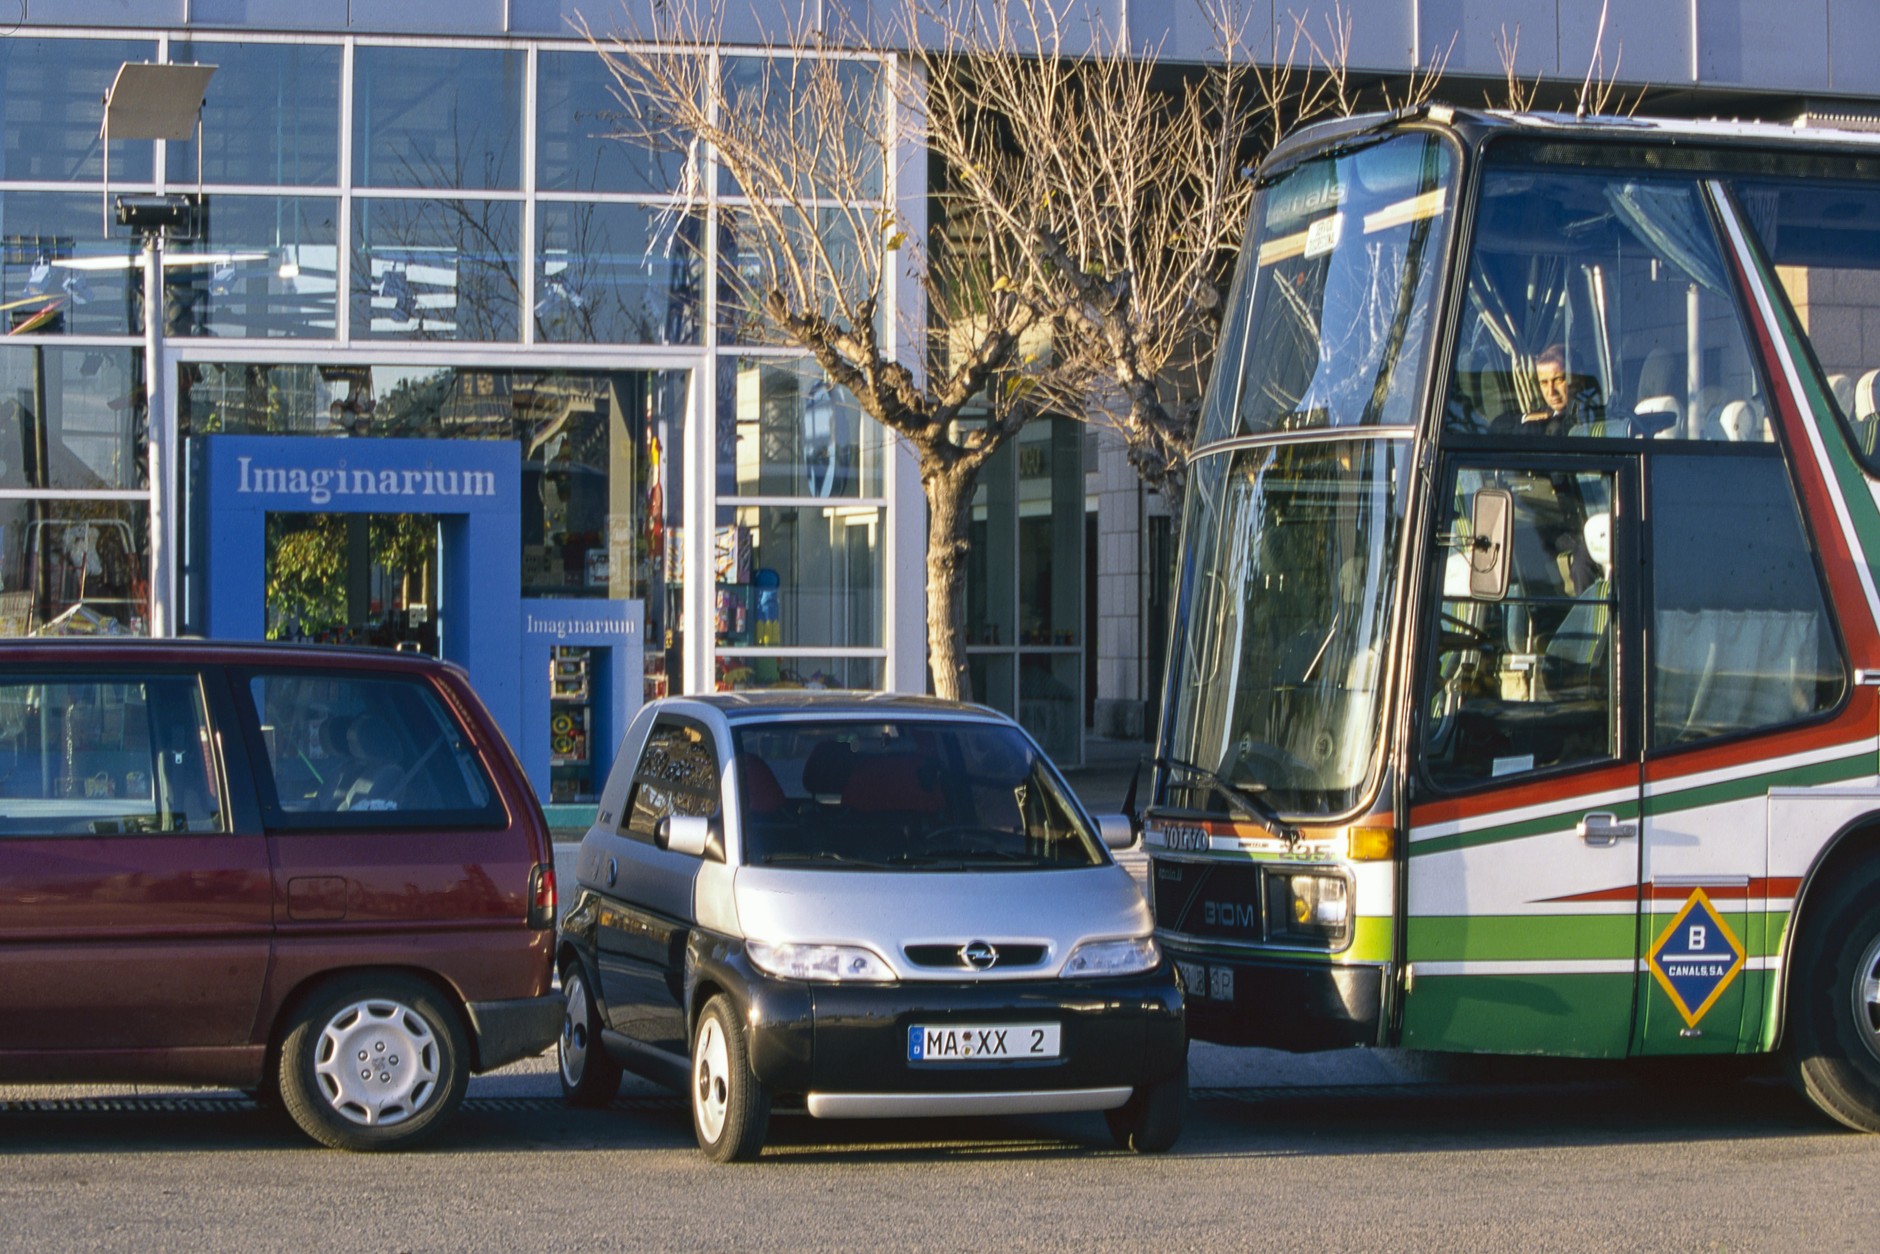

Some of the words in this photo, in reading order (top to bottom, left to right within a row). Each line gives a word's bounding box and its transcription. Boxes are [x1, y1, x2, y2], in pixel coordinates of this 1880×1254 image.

[237, 456, 496, 504] Imaginarium
[527, 614, 635, 639] Imaginarium
[1163, 826, 1210, 852] VOLVO
[1688, 925, 1706, 950] B
[927, 1030, 958, 1055] MA
[976, 1030, 1008, 1055] XX
[1030, 1029, 1045, 1053] 2
